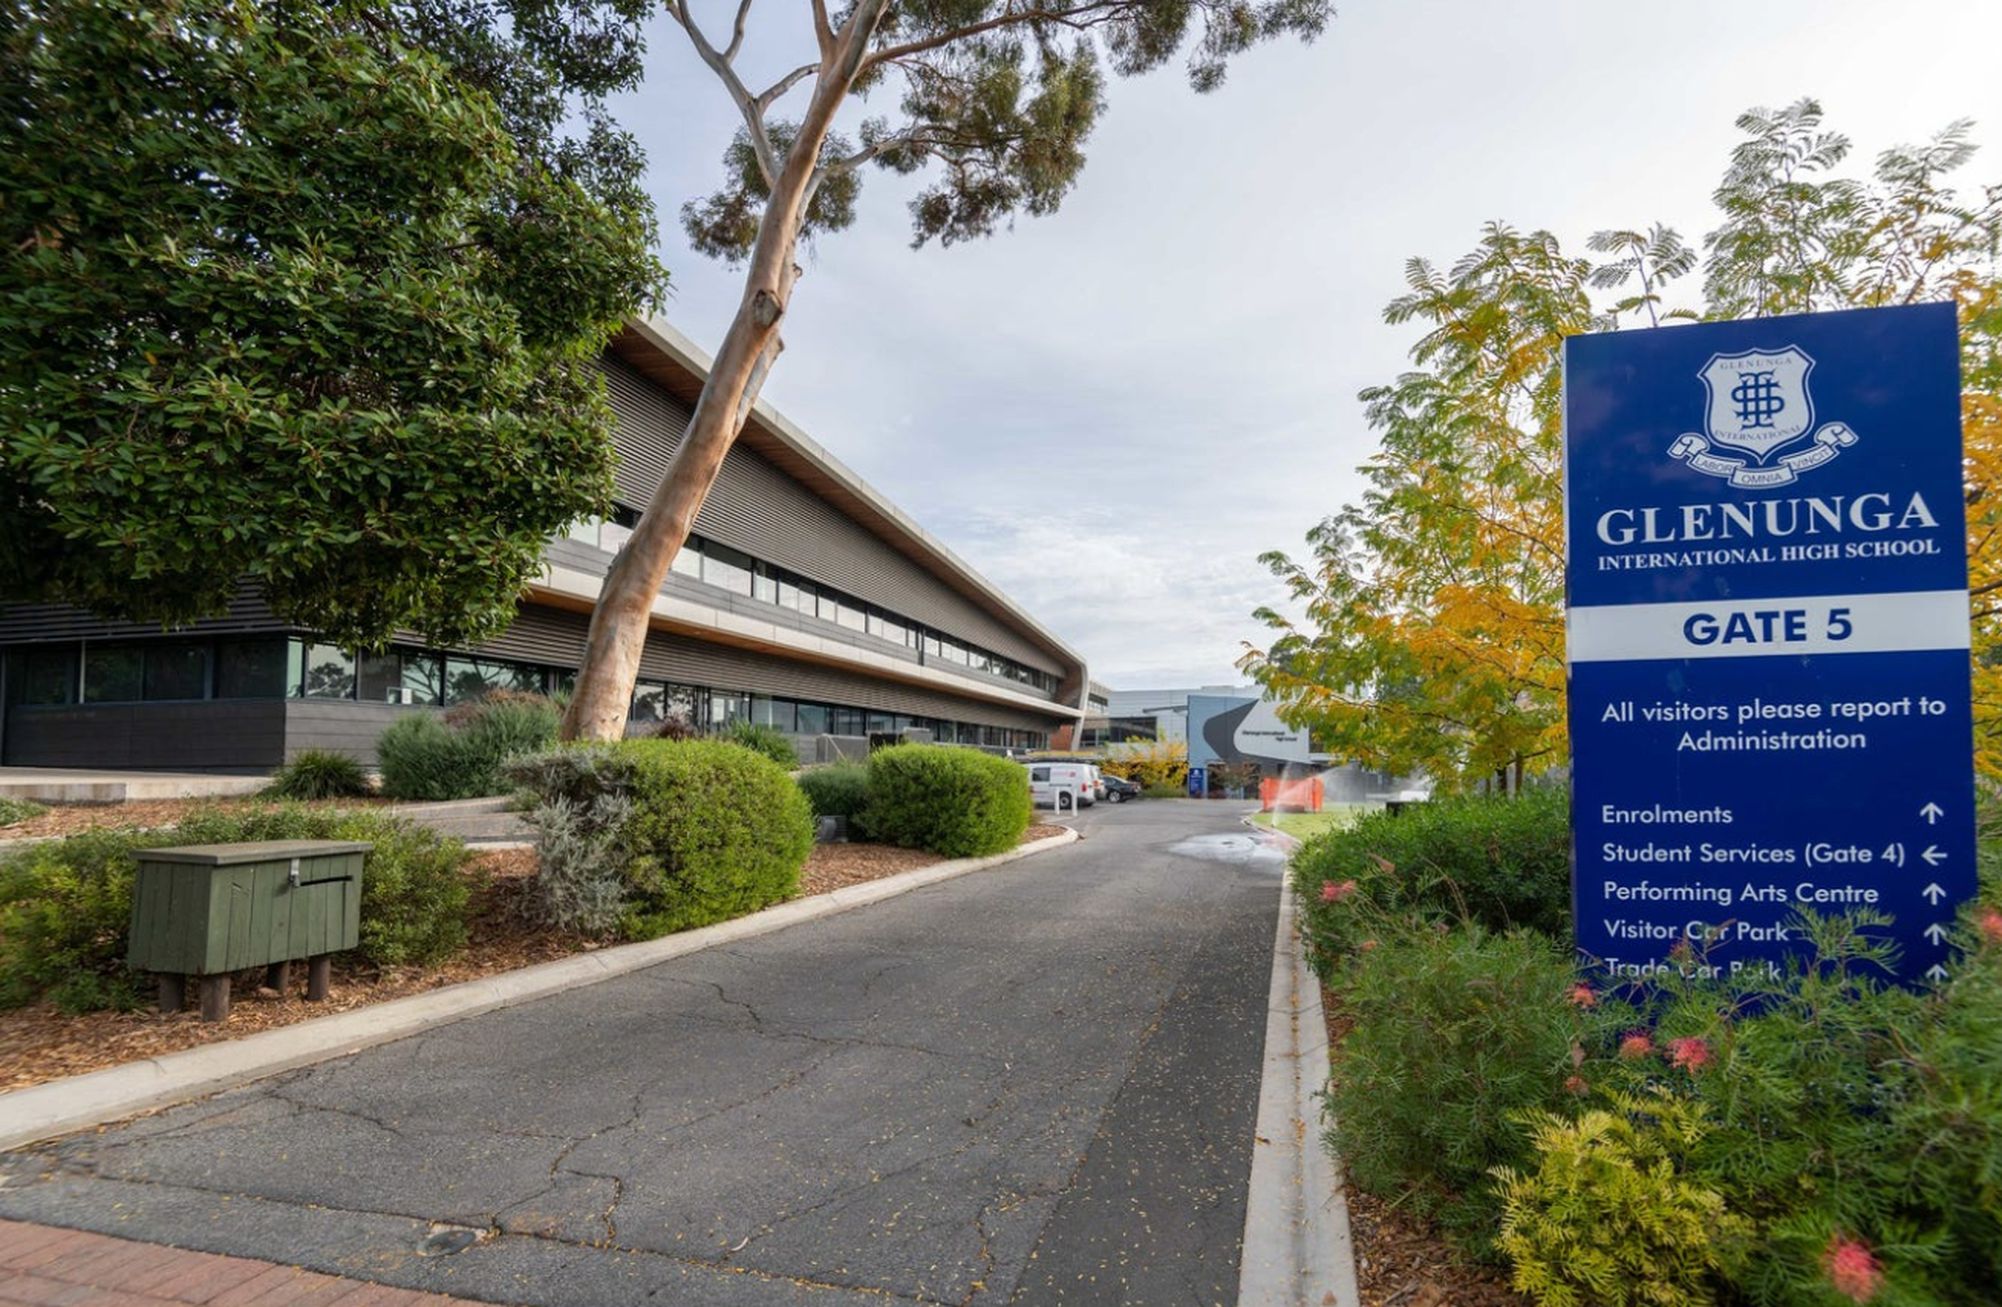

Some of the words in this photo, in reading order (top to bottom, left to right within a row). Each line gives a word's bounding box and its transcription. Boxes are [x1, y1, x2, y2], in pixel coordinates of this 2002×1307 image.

[1719, 356, 1793, 370] GLENUNGA
[1714, 424, 1801, 441] INTERNATIONAL
[1741, 472, 1783, 484] OMNIA
[1596, 491, 1940, 546] GLENUNGA
[1598, 546, 1776, 571] INTERNATIONAL
[1782, 543, 1839, 560] HIGH
[1845, 538, 1941, 558] SCHOOL
[1683, 610, 1807, 646] GATE
[1826, 608, 1853, 641] 5
[1602, 701, 1634, 723] All
[1642, 700, 1729, 721] visitors
[1738, 698, 1822, 724] please
[1831, 696, 1911, 722] report
[1919, 697, 1947, 715] to
[1677, 729, 1867, 752] Administration
[1602, 804, 1733, 825] Enrolments
[1602, 843, 1692, 863] Student
[1701, 843, 1796, 863] Services
[1805, 843, 1873, 868] (Gate
[1881, 842, 1905, 868] 4)
[1604, 881, 1732, 906] Performing
[1740, 883, 1788, 902] Arts
[1795, 883, 1879, 904] Centre
[1604, 919, 1678, 939] Visitor
[1737, 921, 1789, 942] Park
[1605, 957, 1670, 978] Trade
[1730, 961, 1782, 981] Pk
